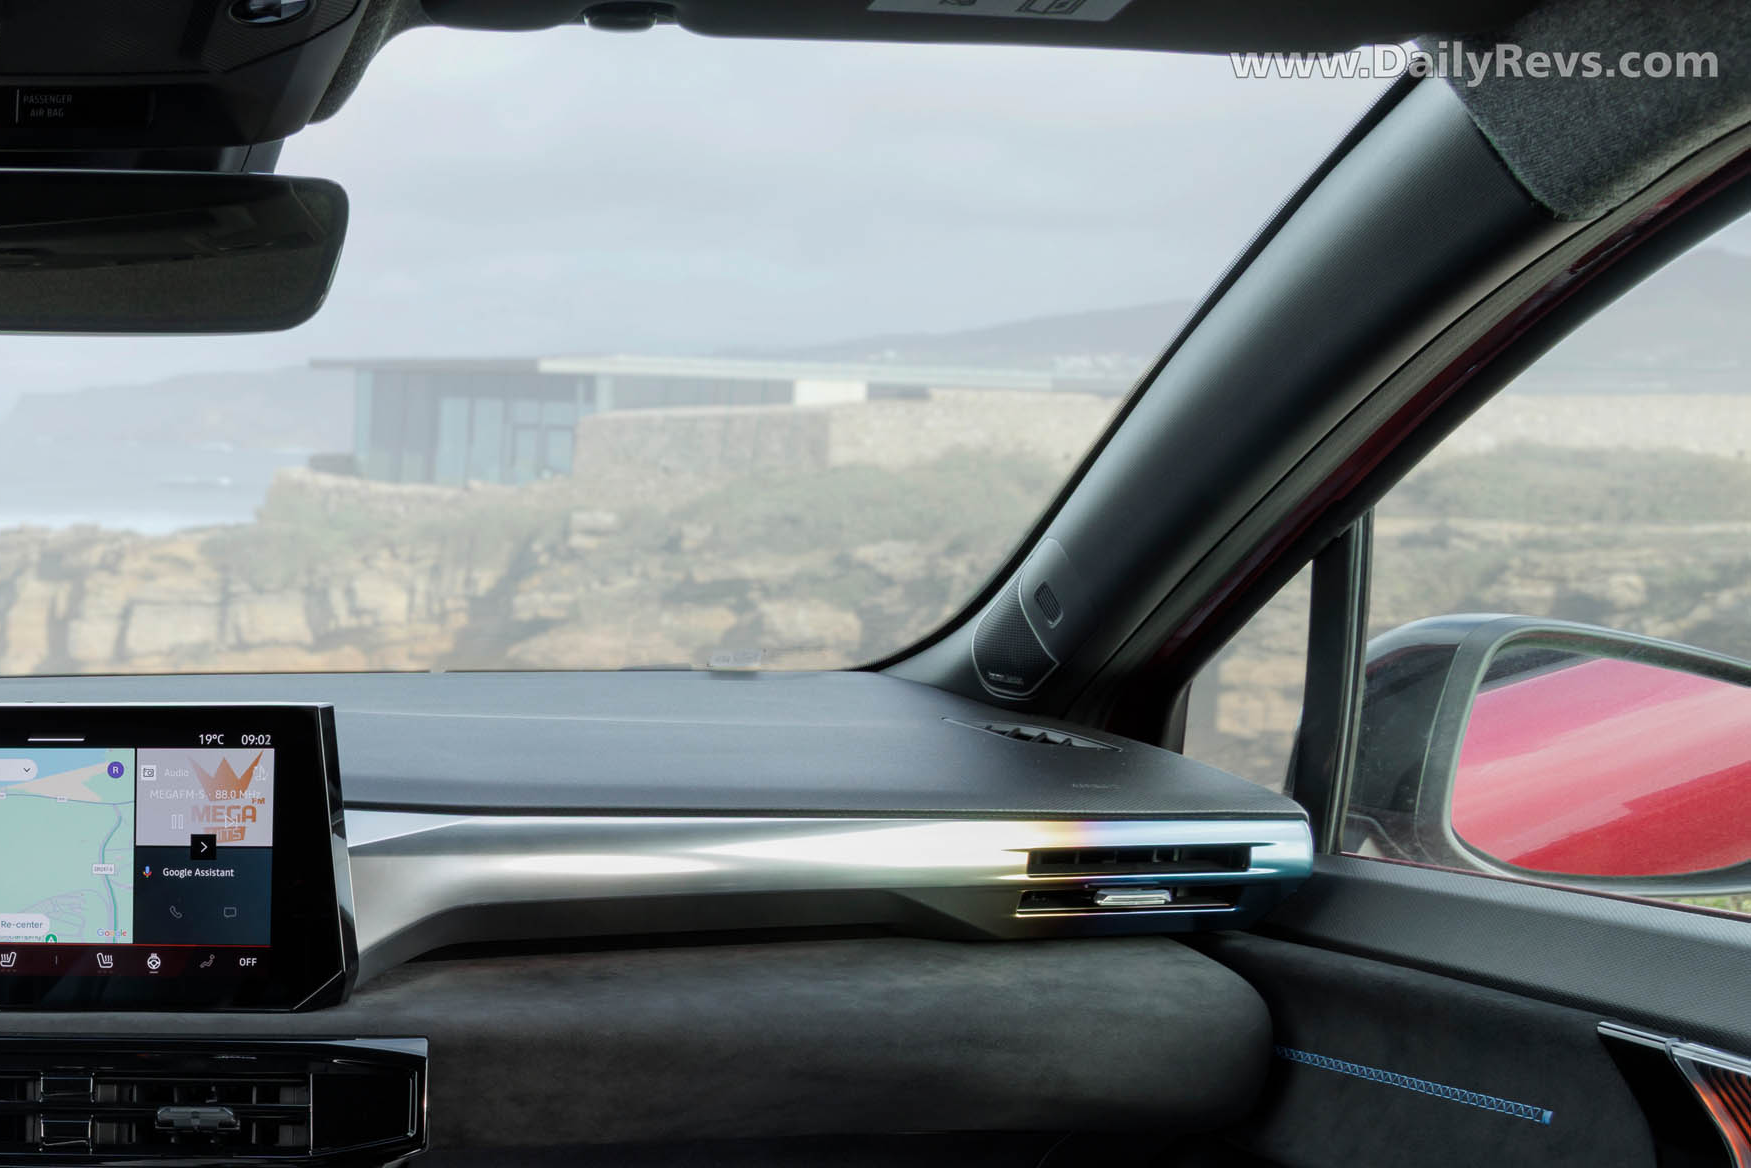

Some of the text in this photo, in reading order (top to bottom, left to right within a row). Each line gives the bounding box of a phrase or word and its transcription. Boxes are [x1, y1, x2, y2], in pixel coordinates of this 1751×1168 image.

[23, 94, 73, 105] PASSENGER
[30, 107, 64, 118] AIR BAG
[241, 734, 272, 745] 09:02
[164, 768, 189, 777] Audio
[215, 789, 236, 800] 88.0
[191, 804, 257, 823] MEGA
[163, 867, 235, 879] Google Assistant
[0, 920, 44, 930] Re-center
[96, 927, 127, 938] Google
[239, 957, 258, 967] OFF
